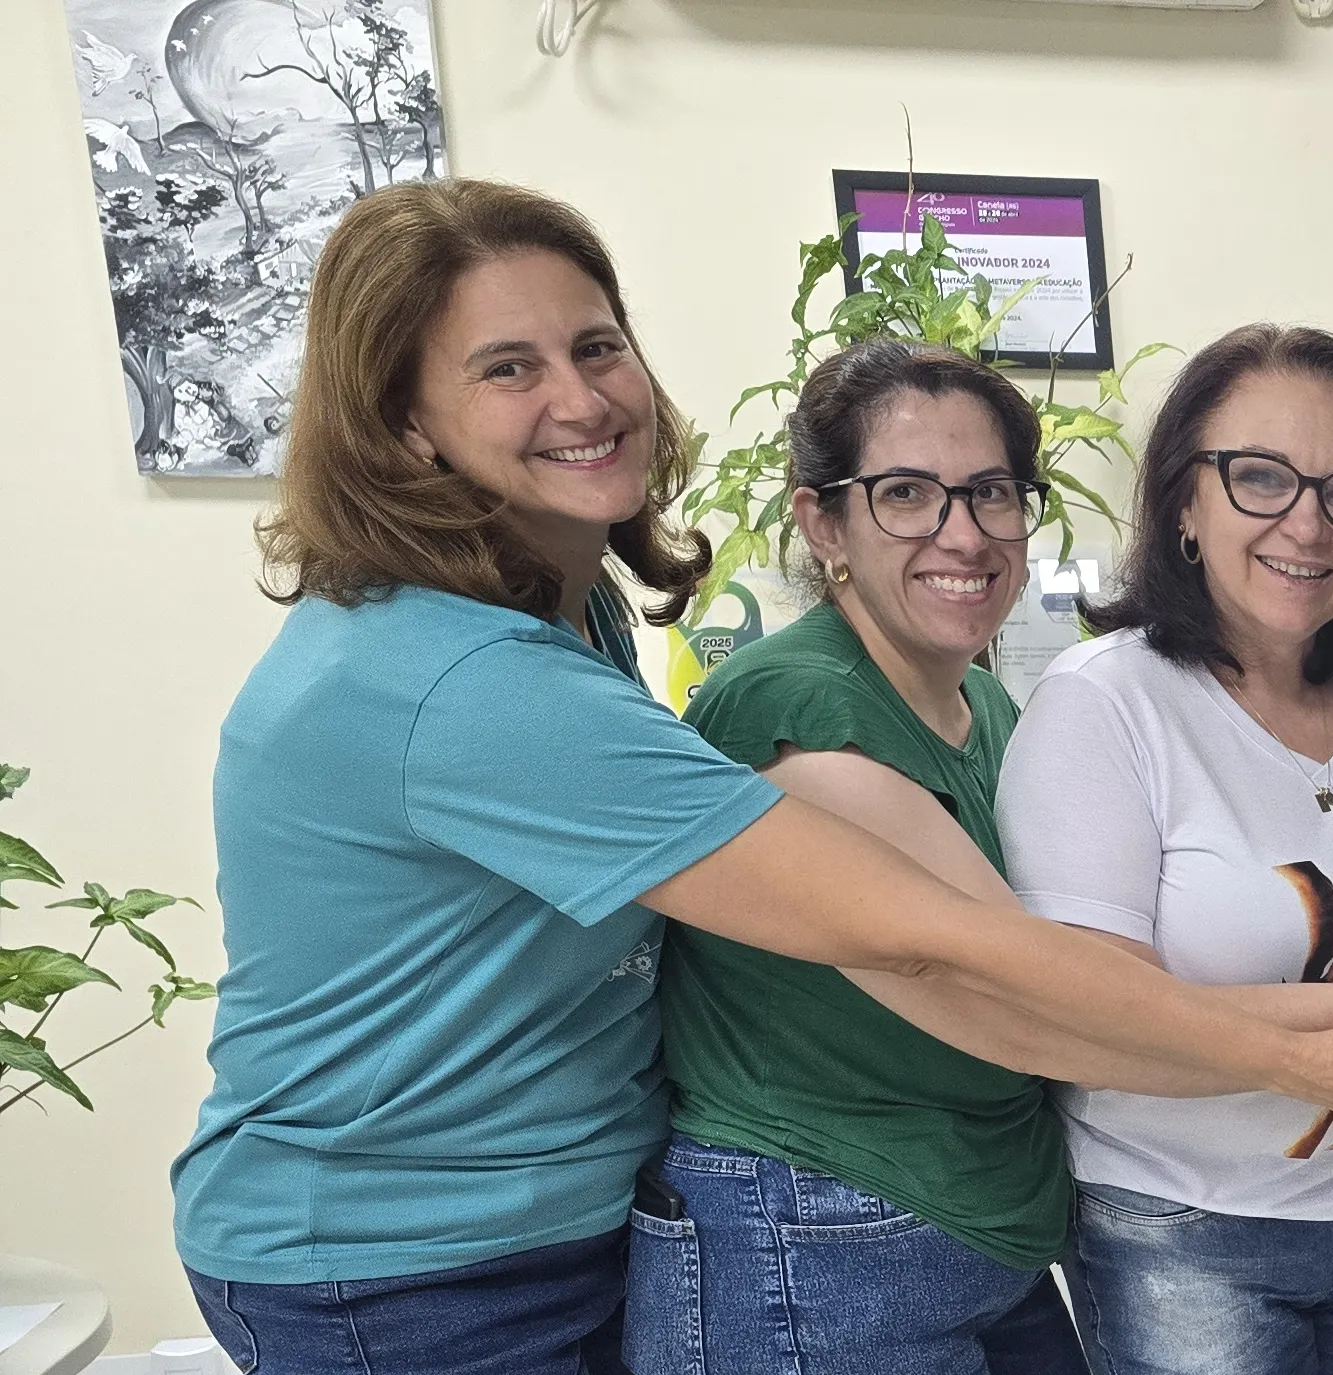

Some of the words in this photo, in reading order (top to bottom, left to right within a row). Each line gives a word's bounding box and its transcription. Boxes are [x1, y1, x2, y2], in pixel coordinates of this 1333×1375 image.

[918, 206, 967, 214] CONGRESSO
[957, 256, 1019, 268] INOVADOR
[1021, 258, 1051, 269] 2024
[1044, 278, 1083, 288] EDUCAÇÃO
[702, 638, 732, 648] 2025
